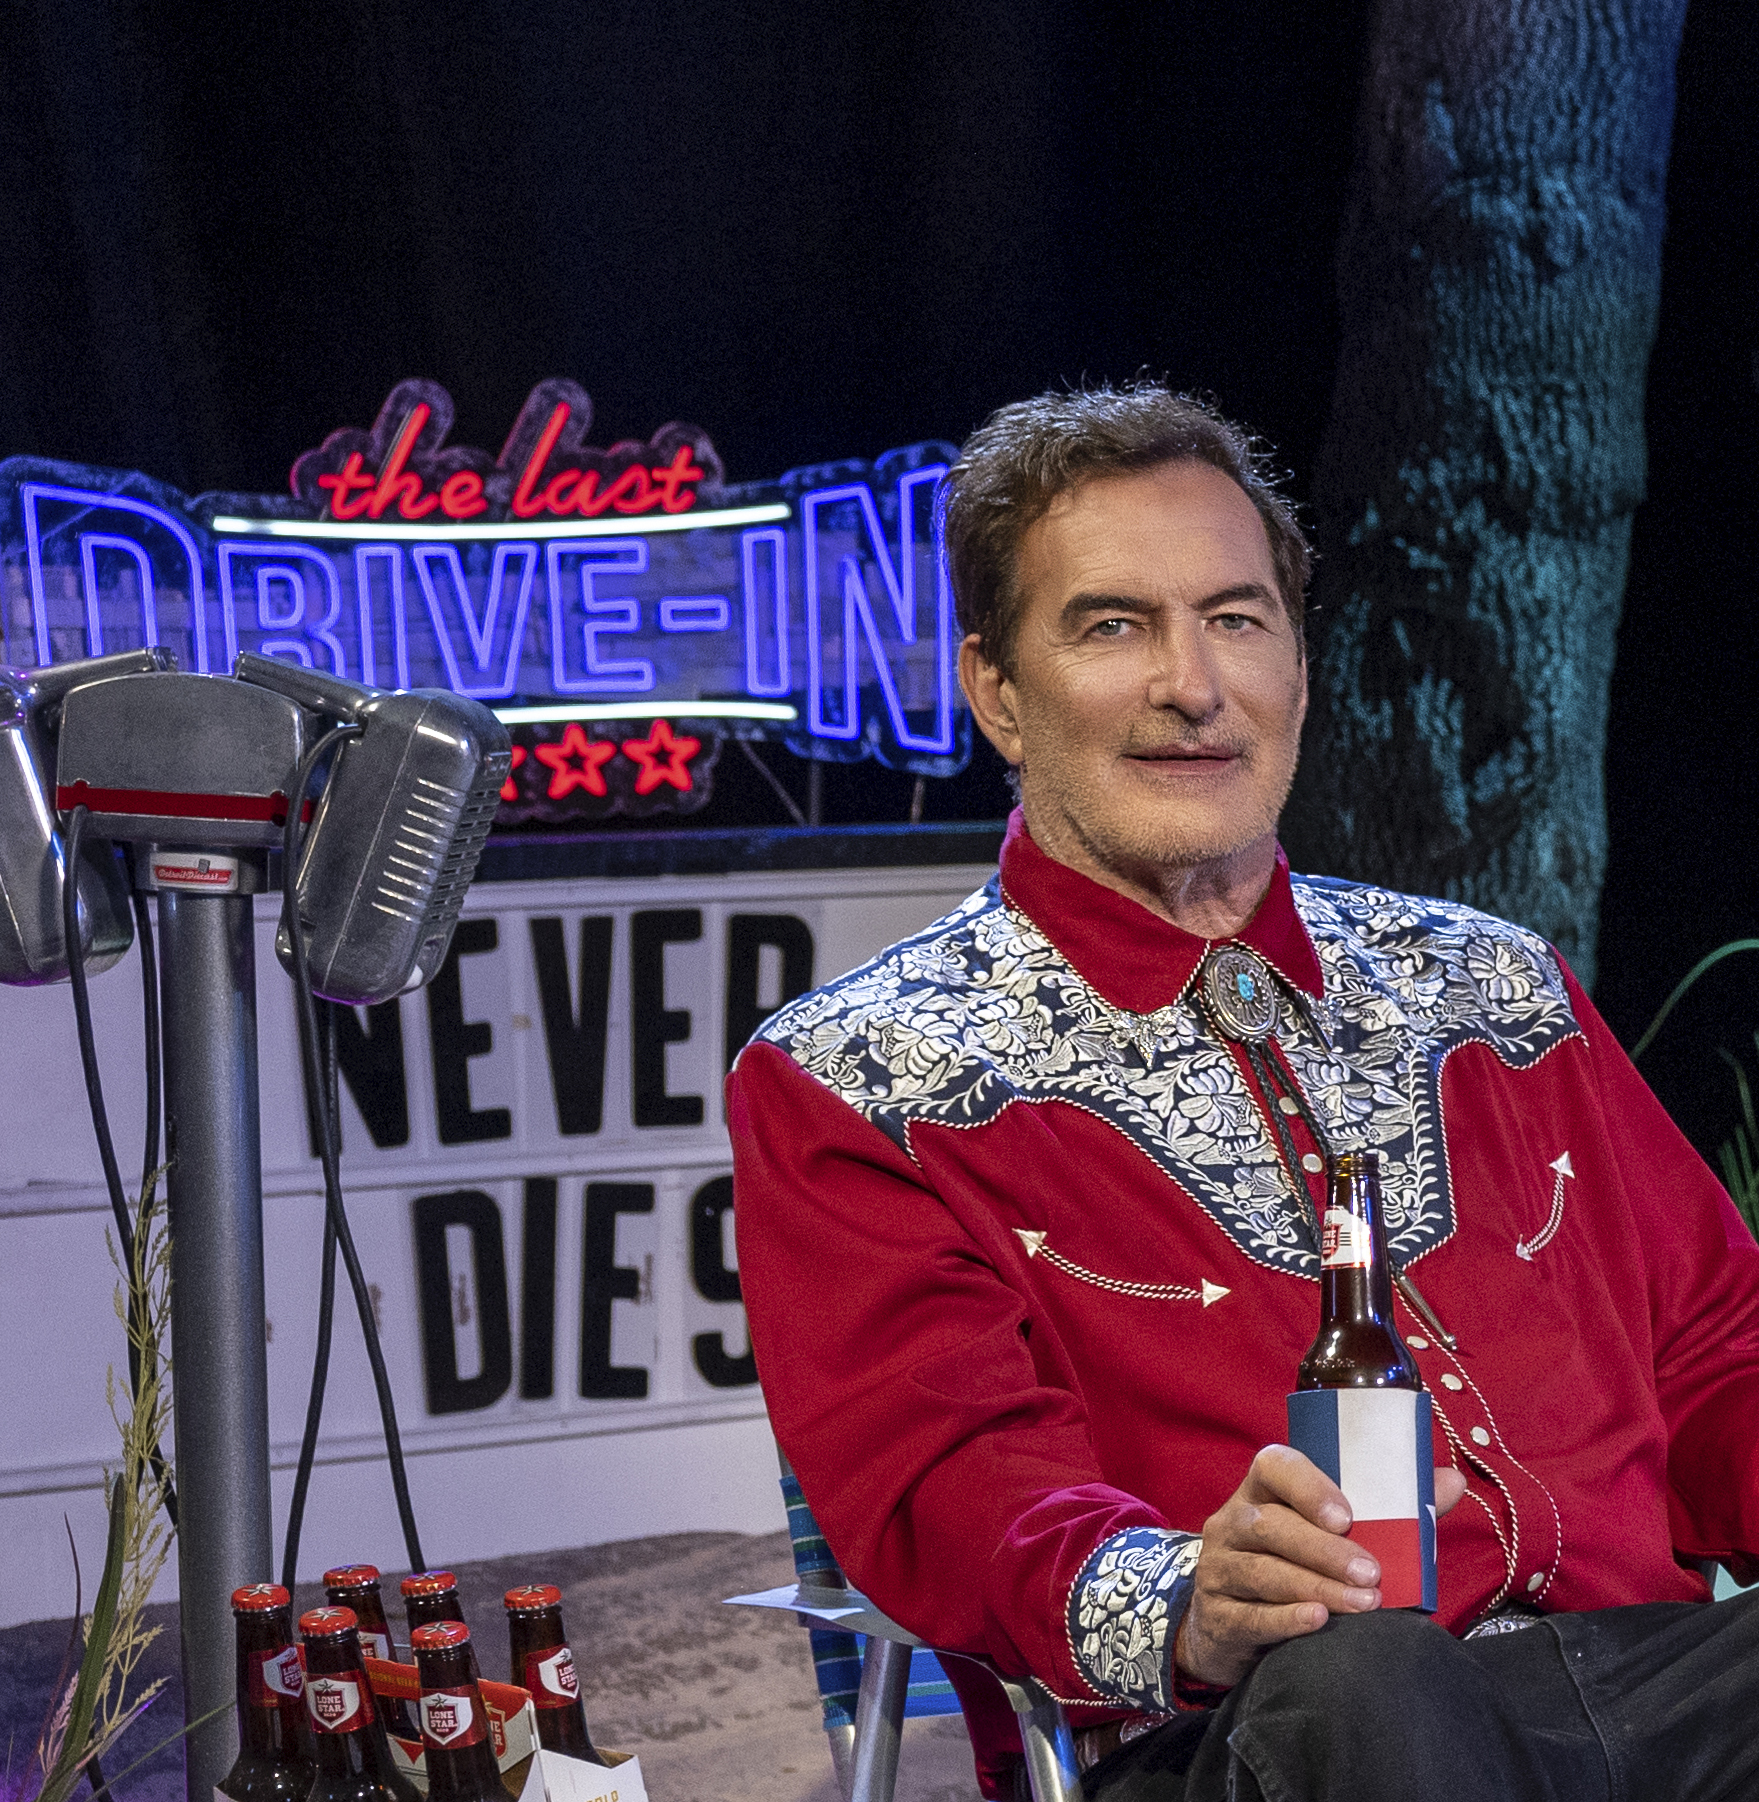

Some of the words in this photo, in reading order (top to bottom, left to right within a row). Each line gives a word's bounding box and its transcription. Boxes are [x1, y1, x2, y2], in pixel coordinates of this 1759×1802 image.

[318, 401, 488, 521] the
[511, 401, 707, 519] last
[22, 465, 956, 753] DRIVE-IN
[317, 1694, 342, 1706] LONE
[318, 1703, 342, 1714] STAR
[429, 1710, 454, 1720] LONE
[430, 1719, 455, 1728] STAR
